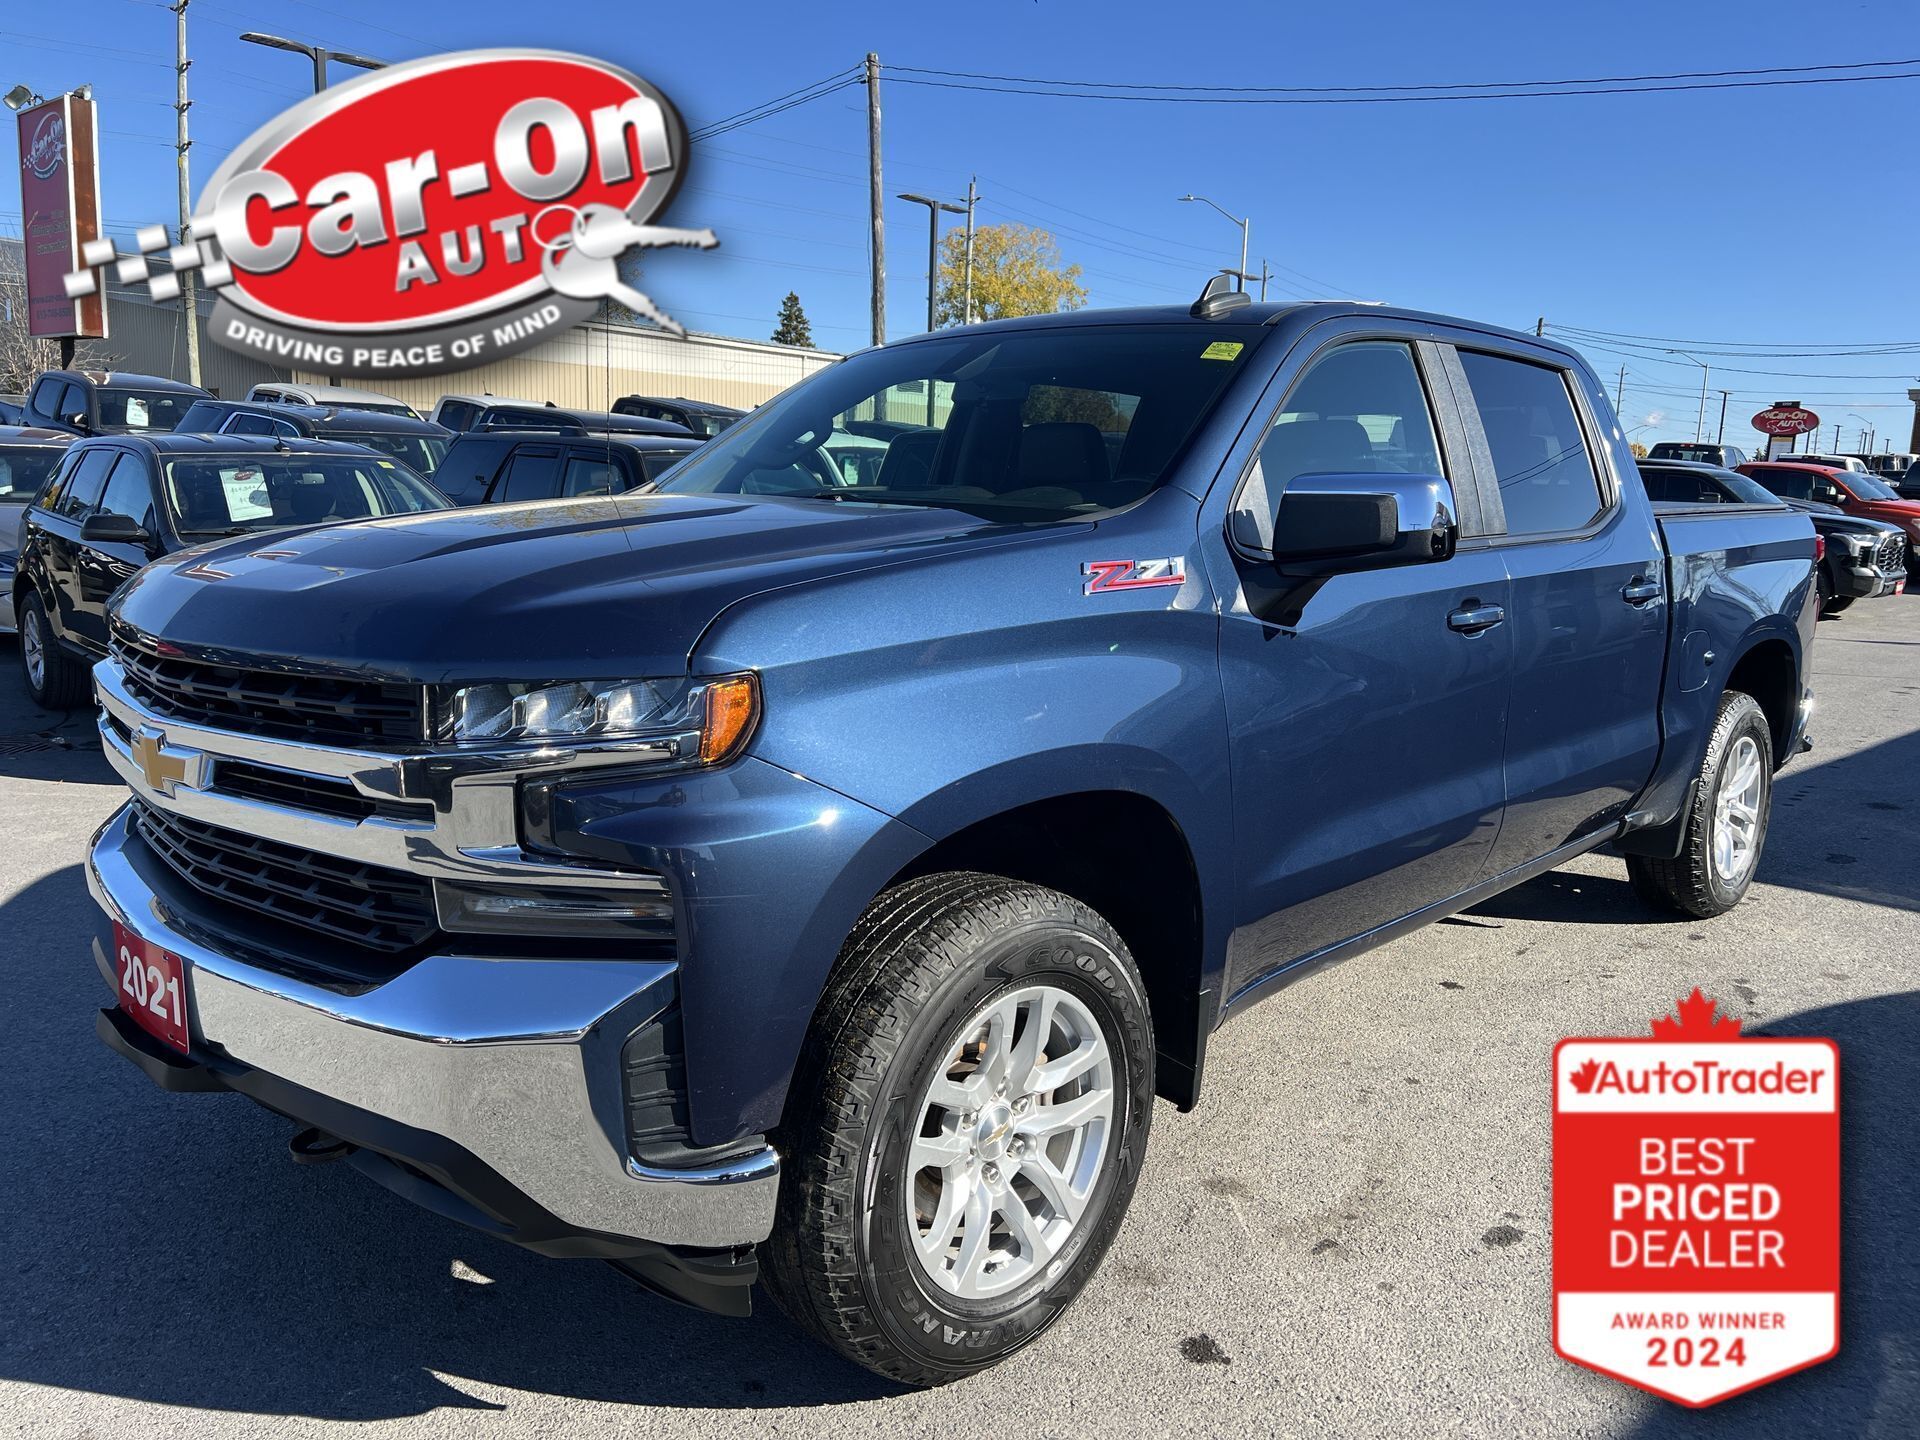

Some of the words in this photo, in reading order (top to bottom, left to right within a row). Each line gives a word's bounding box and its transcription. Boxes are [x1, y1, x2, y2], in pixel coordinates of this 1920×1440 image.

[1771, 411, 1808, 420] Car-On
[1082, 556, 1186, 595] Z71
[120, 945, 182, 1027] 2021
